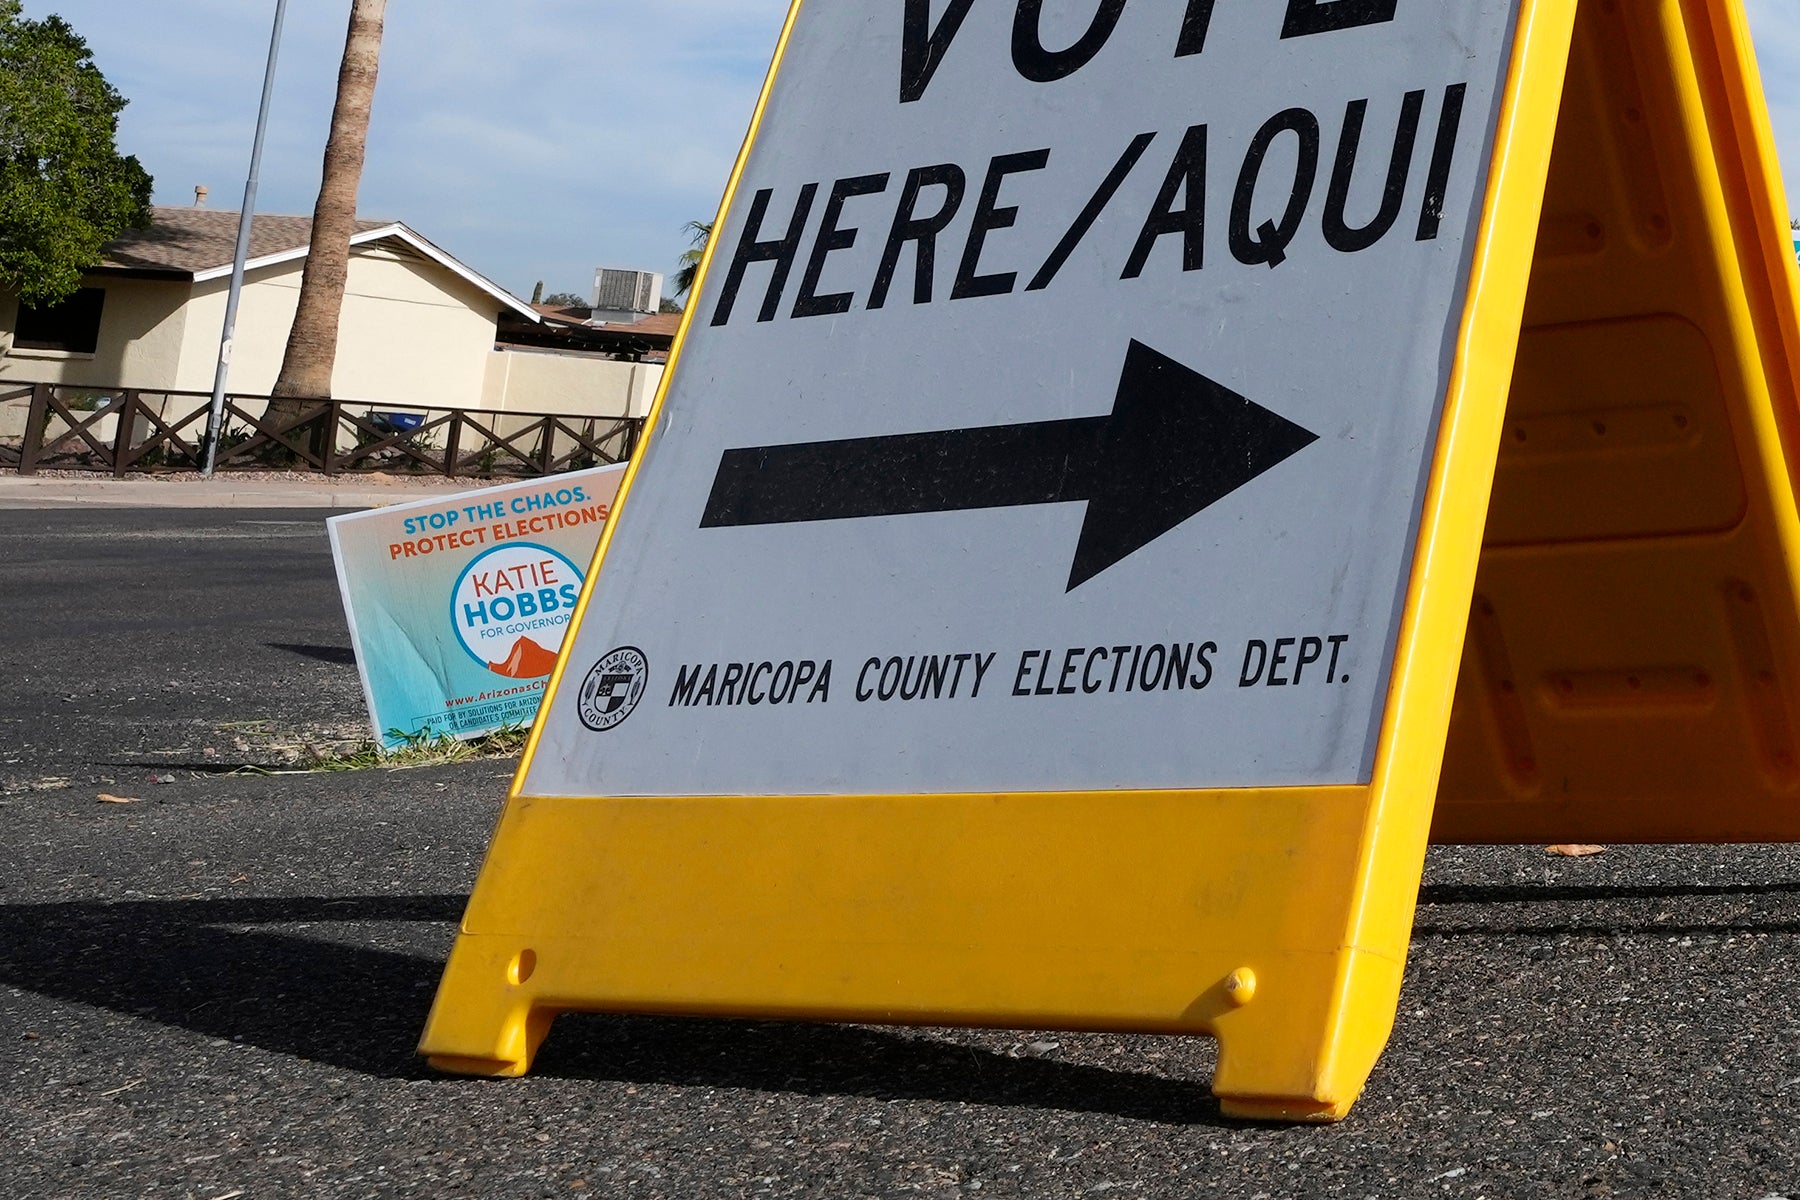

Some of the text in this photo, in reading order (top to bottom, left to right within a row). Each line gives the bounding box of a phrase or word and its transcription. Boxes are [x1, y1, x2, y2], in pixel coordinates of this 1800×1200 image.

[710, 83, 1466, 326] HERE/AQUI
[404, 486, 591, 535] STOP THE CHAOS.
[389, 505, 609, 560] PROTECT ELECTIONS
[472, 560, 559, 598] KATIE
[464, 584, 578, 627] HOBBS
[480, 627, 504, 639] FOR
[595, 652, 643, 676] MARICOPA
[668, 634, 1350, 707] MARICOPA COUNTY ELECTIONS DEPT.
[445, 680, 550, 707] www.ArizonasCh
[468, 705, 503, 717] SOLUTIONS
[584, 707, 626, 725] COUNTY
